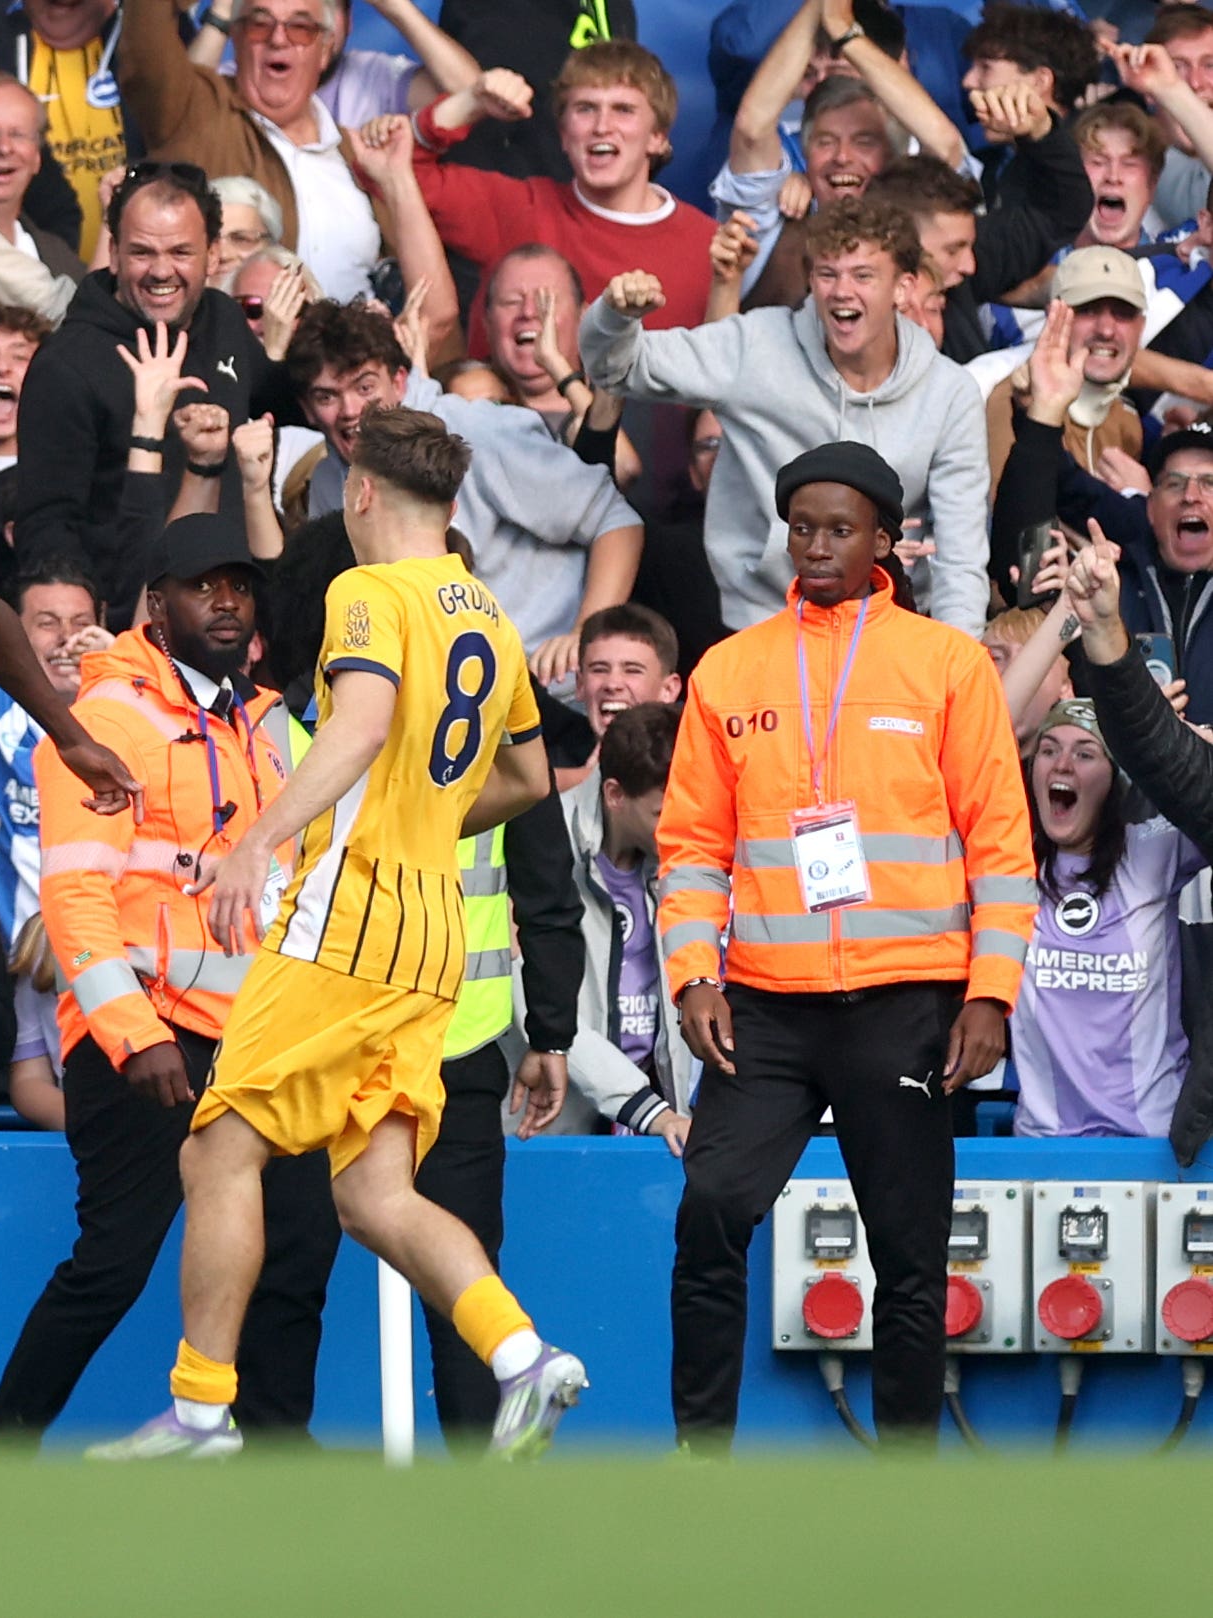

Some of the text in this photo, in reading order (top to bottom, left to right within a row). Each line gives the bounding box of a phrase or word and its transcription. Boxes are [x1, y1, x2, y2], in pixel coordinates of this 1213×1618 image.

[437, 583, 499, 627] GRUDA
[429, 630, 496, 788] 8
[1025, 948, 1148, 974] AMERICAN
[1036, 969, 1148, 992] EXPRESS
